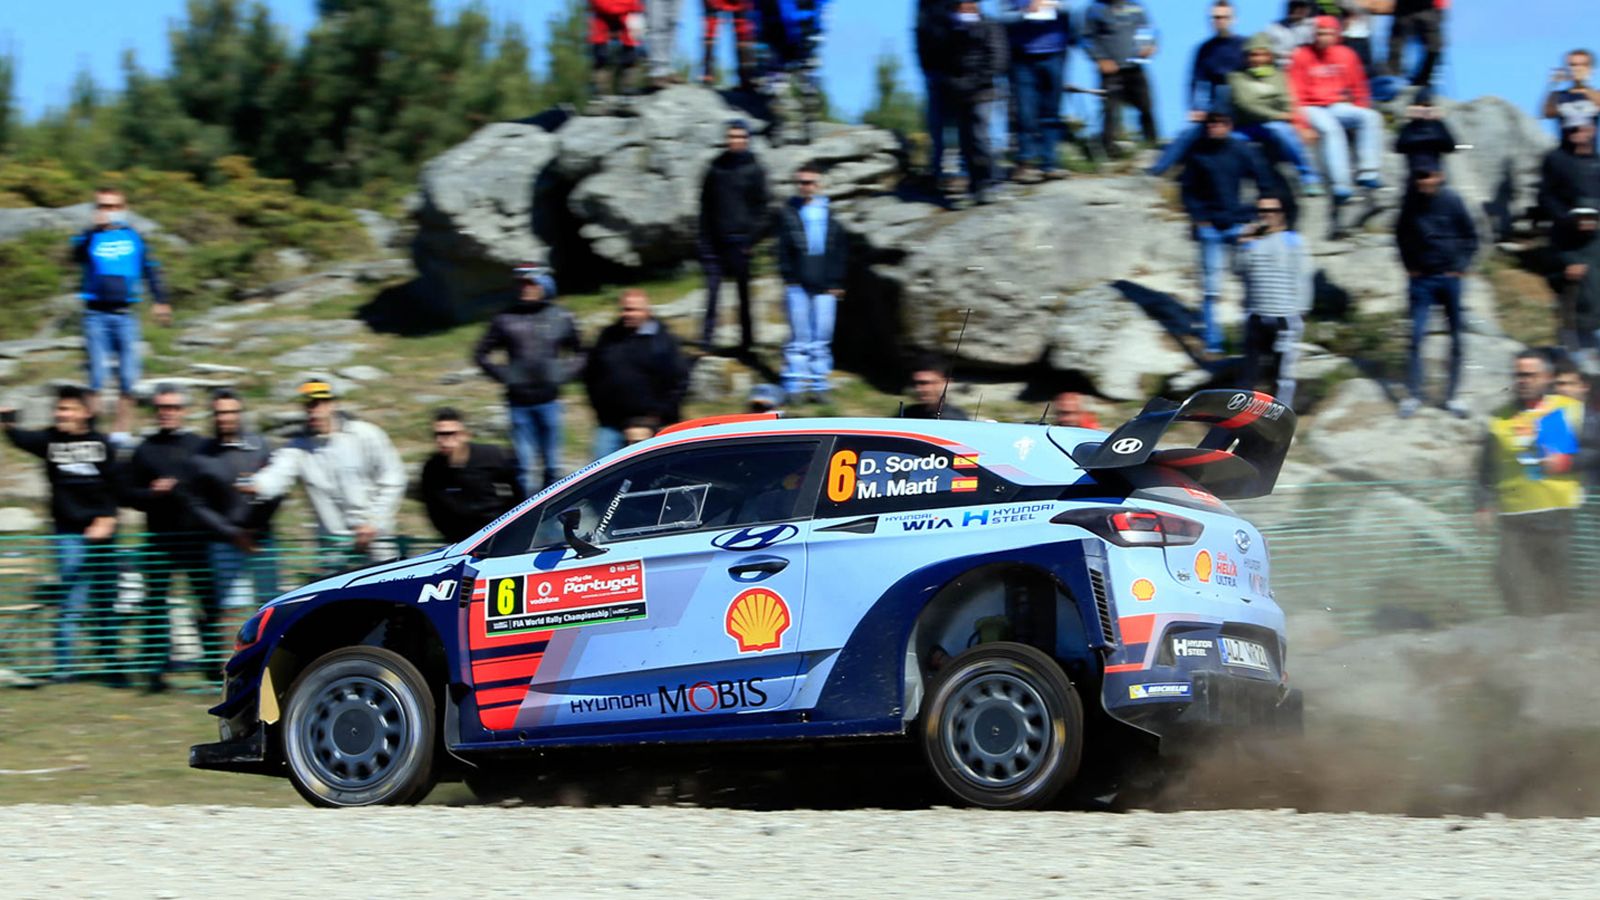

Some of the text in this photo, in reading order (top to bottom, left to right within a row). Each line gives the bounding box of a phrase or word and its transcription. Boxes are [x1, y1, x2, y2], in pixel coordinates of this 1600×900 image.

[860, 454, 948, 475] D. Sordo
[827, 450, 857, 502] 6
[857, 476, 939, 499] M. Martí
[885, 513, 932, 521] HYUNDAI
[992, 513, 1036, 525] STEEL
[993, 503, 1055, 516] HYUNDAI
[563, 574, 639, 594] Portugal
[497, 578, 516, 615] 6
[529, 596, 559, 605] vodafone
[513, 619, 524, 628] FIA
[525, 617, 544, 627] World
[546, 614, 562, 625] Rally
[563, 609, 609, 622] Championship
[1187, 648, 1208, 656] STEEL
[570, 677, 768, 714] HYUNDAI MOBIS
